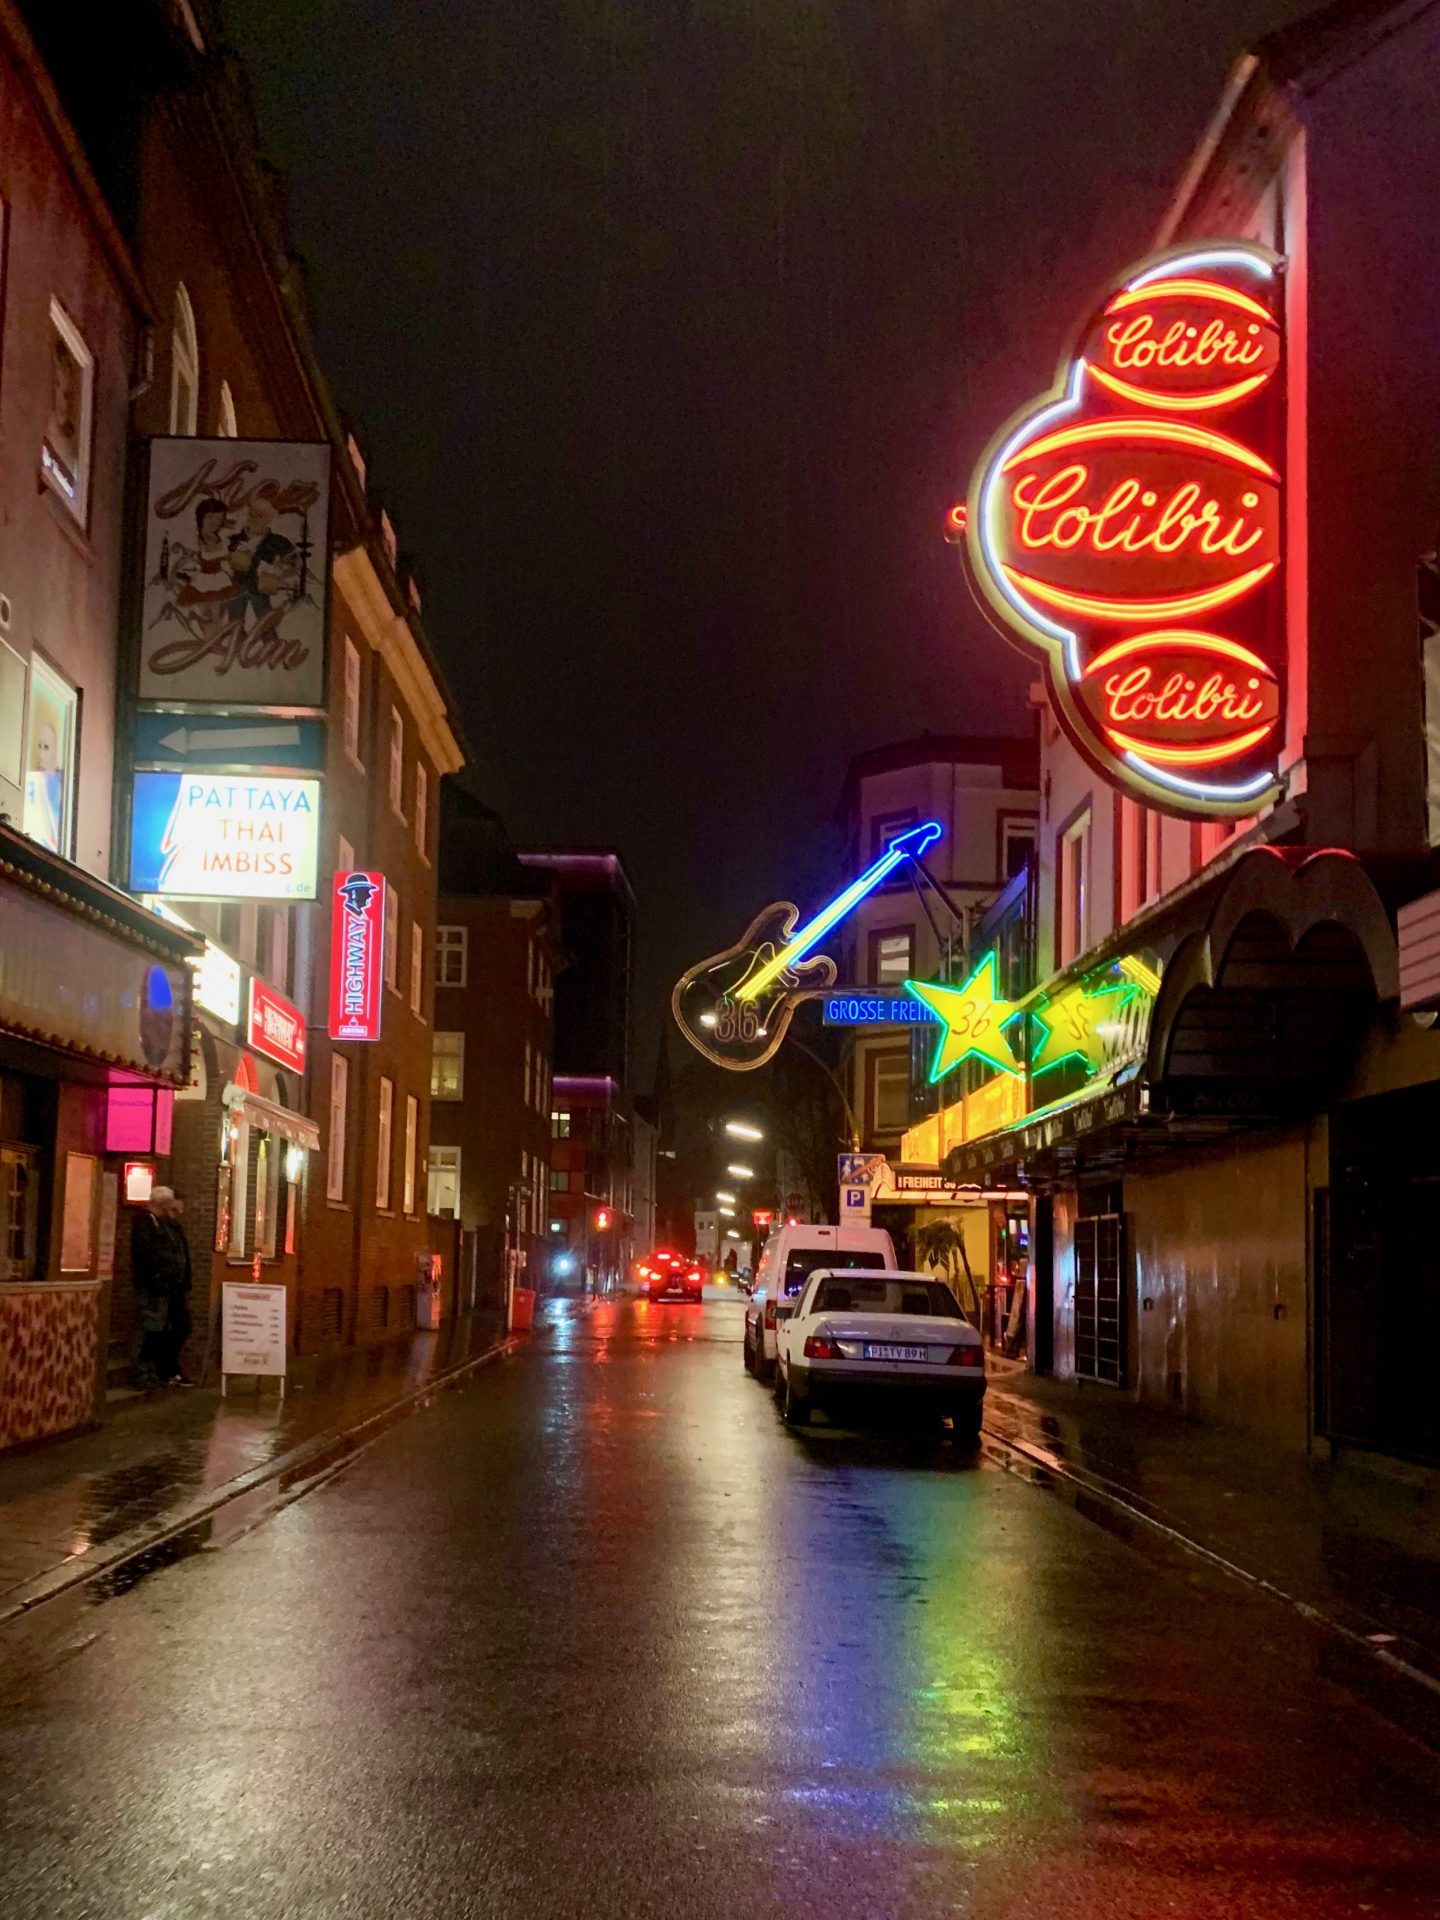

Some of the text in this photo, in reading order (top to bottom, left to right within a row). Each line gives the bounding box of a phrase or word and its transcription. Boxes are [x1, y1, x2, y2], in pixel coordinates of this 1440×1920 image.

[1107, 314, 1263, 368] Colibri
[1013, 464, 1263, 555] Colibri
[1105, 665, 1263, 722] Colibri
[188, 784, 312, 813] PATTAYA
[217, 818, 284, 843] THAI
[202, 851, 293, 875] IMBISS
[346, 919, 366, 1014] HIGHWAY
[714, 998, 759, 1042] 36
[829, 1000, 940, 1020] GROSSE FREIH
[951, 1001, 990, 1038] 36
[850, 1191, 861, 1205] P
[903, 1177, 942, 1188] FREIHEIT
